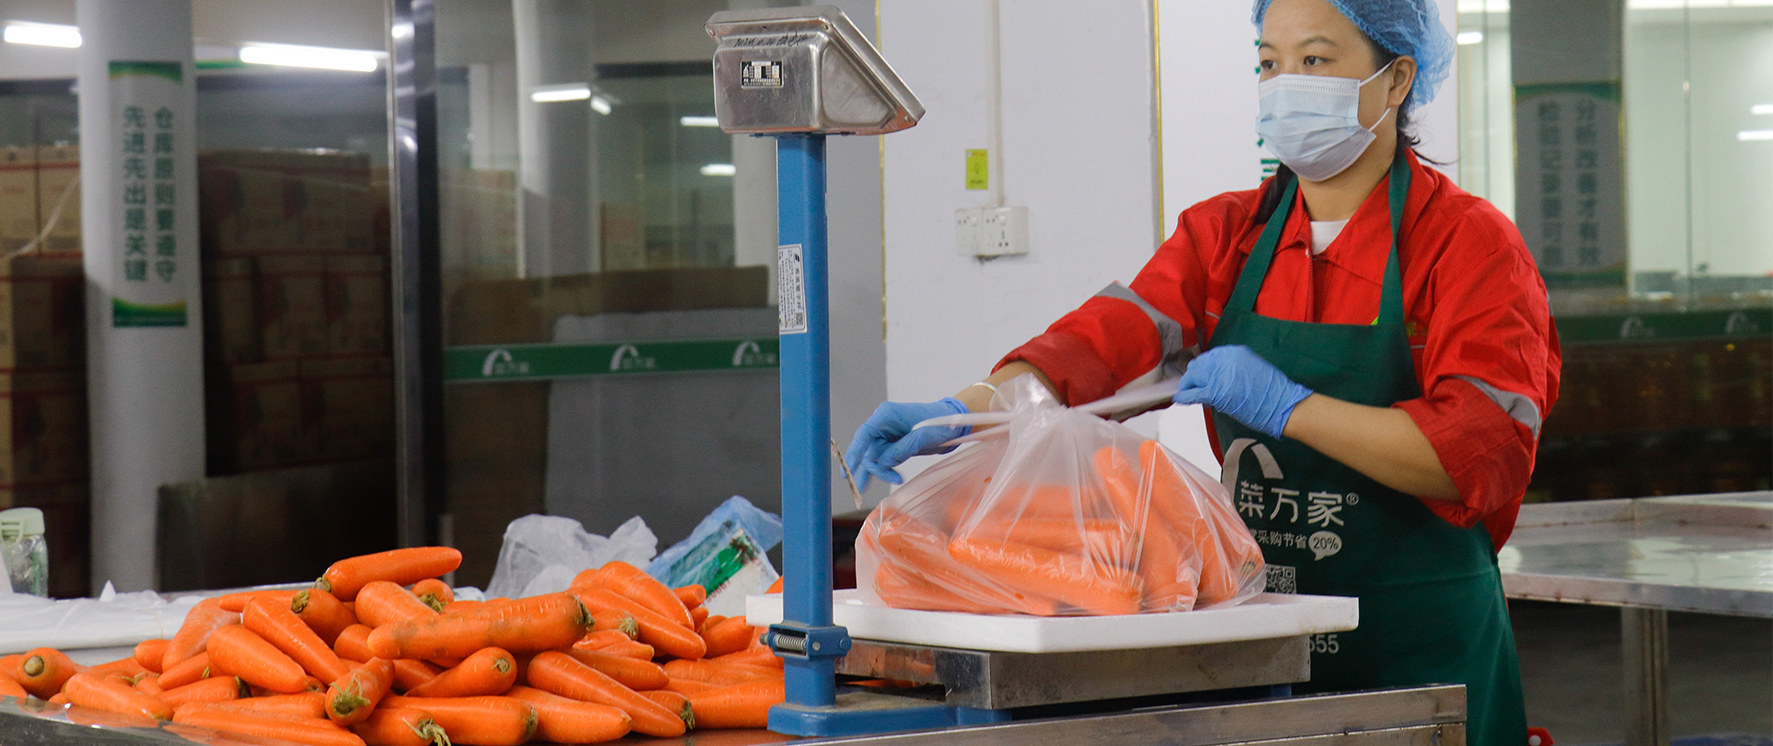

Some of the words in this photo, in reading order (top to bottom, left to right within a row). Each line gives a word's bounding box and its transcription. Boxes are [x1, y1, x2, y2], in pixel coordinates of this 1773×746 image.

[123, 106, 147, 282] 先进先出是关键
[154, 106, 176, 283] 仓库原则要遵守
[1312, 537, 1339, 550] 20%
